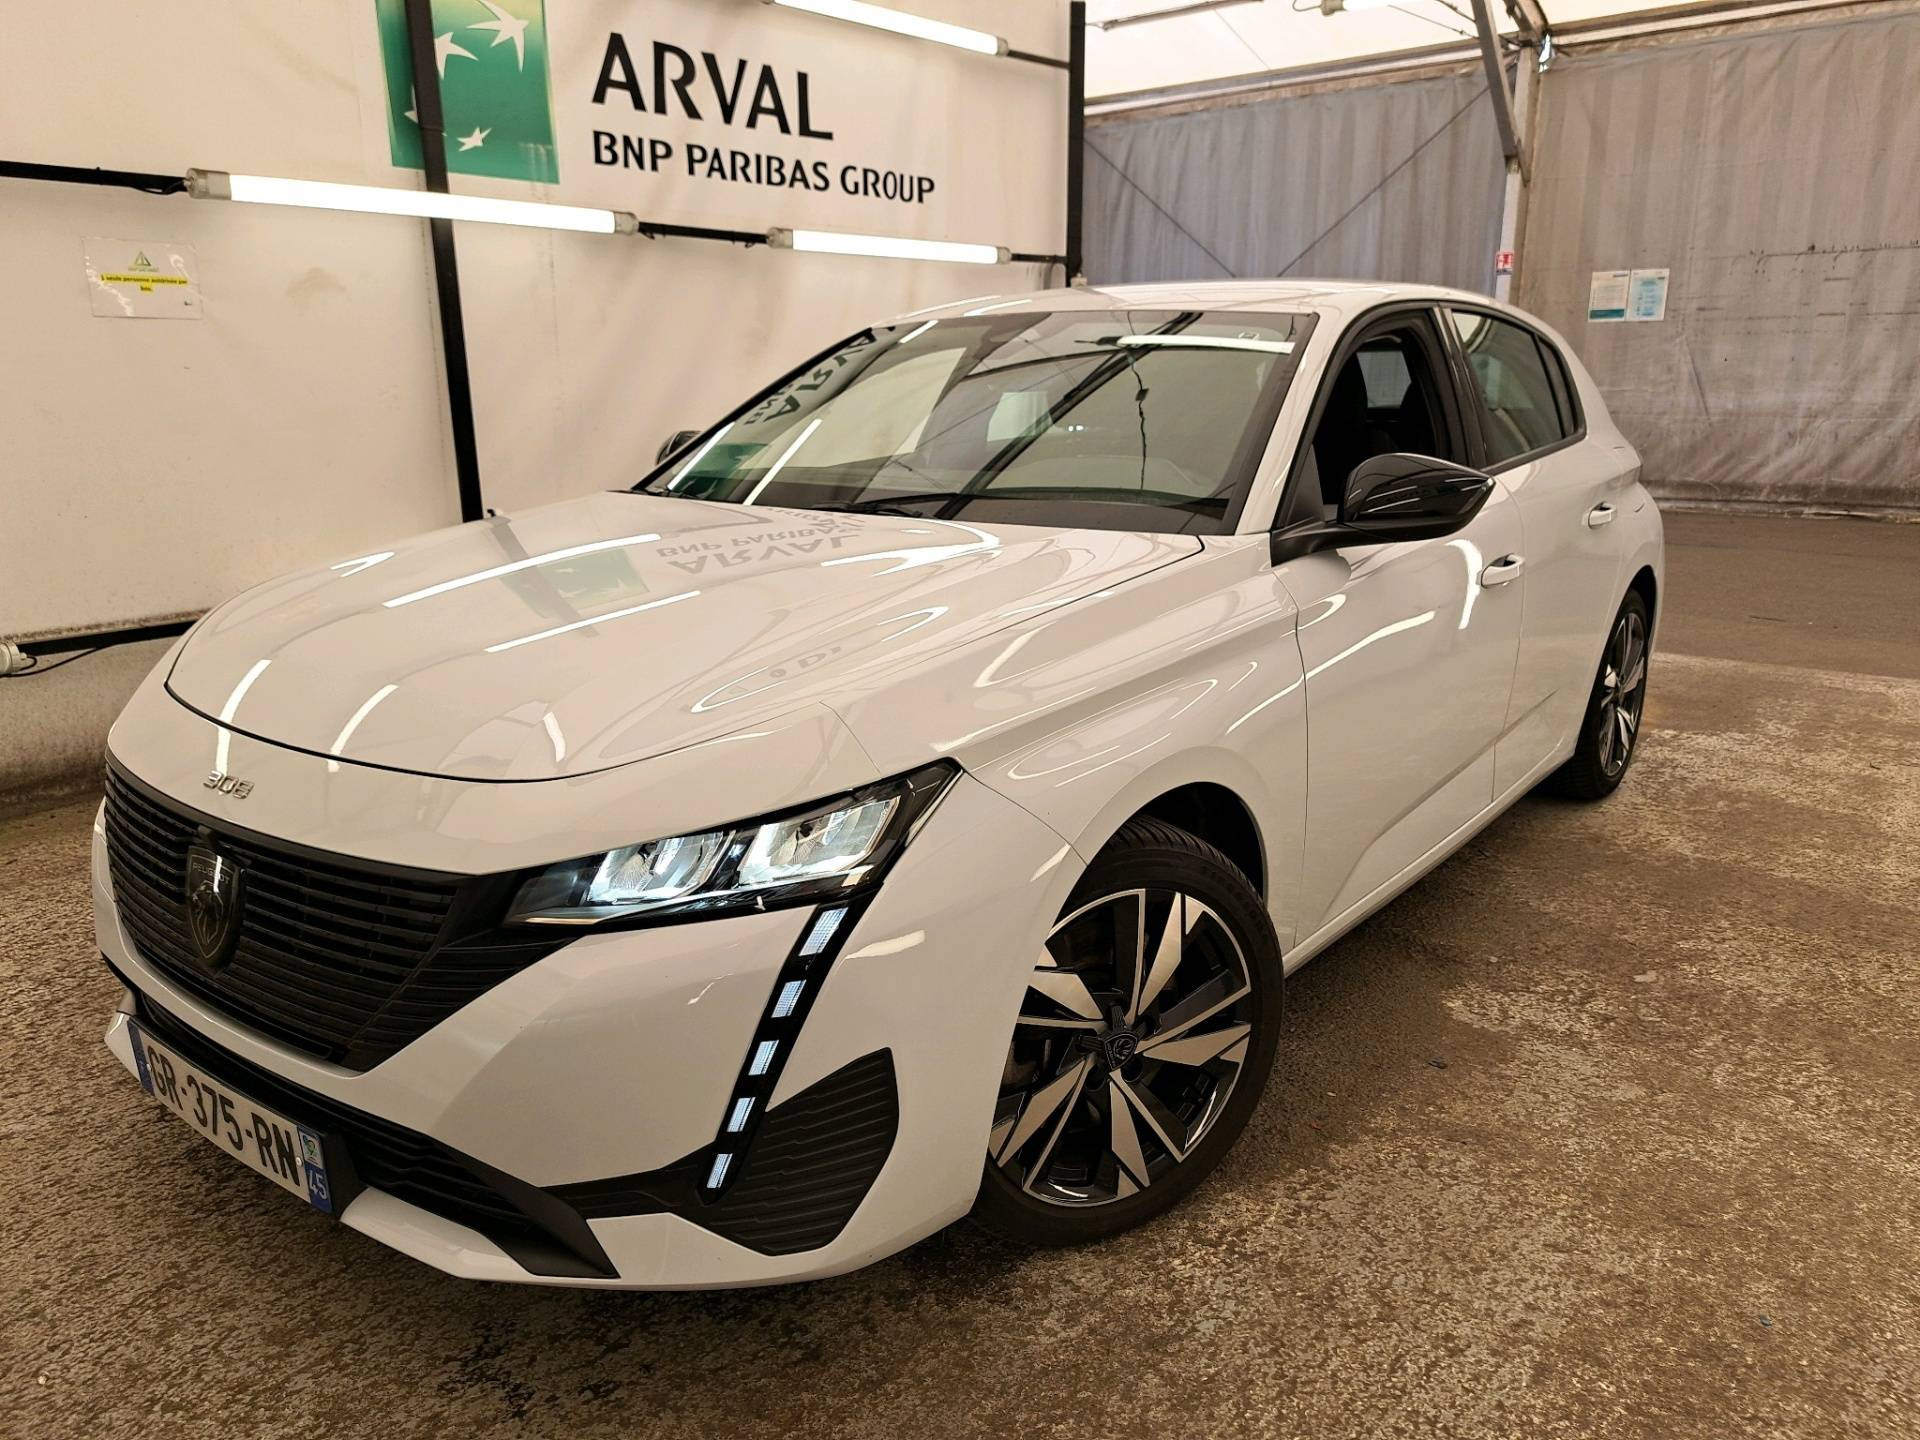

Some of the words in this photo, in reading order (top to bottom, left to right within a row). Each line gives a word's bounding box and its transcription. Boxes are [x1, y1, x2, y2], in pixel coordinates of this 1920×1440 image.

[592, 32, 834, 140] ARVAL
[593, 131, 672, 171] BNP
[687, 144, 829, 191] PARIBAS
[841, 166, 934, 203] GROUP
[203, 769, 255, 800] 308
[147, 1045, 301, 1187] GR-375-RN
[308, 1169, 328, 1200] 45
